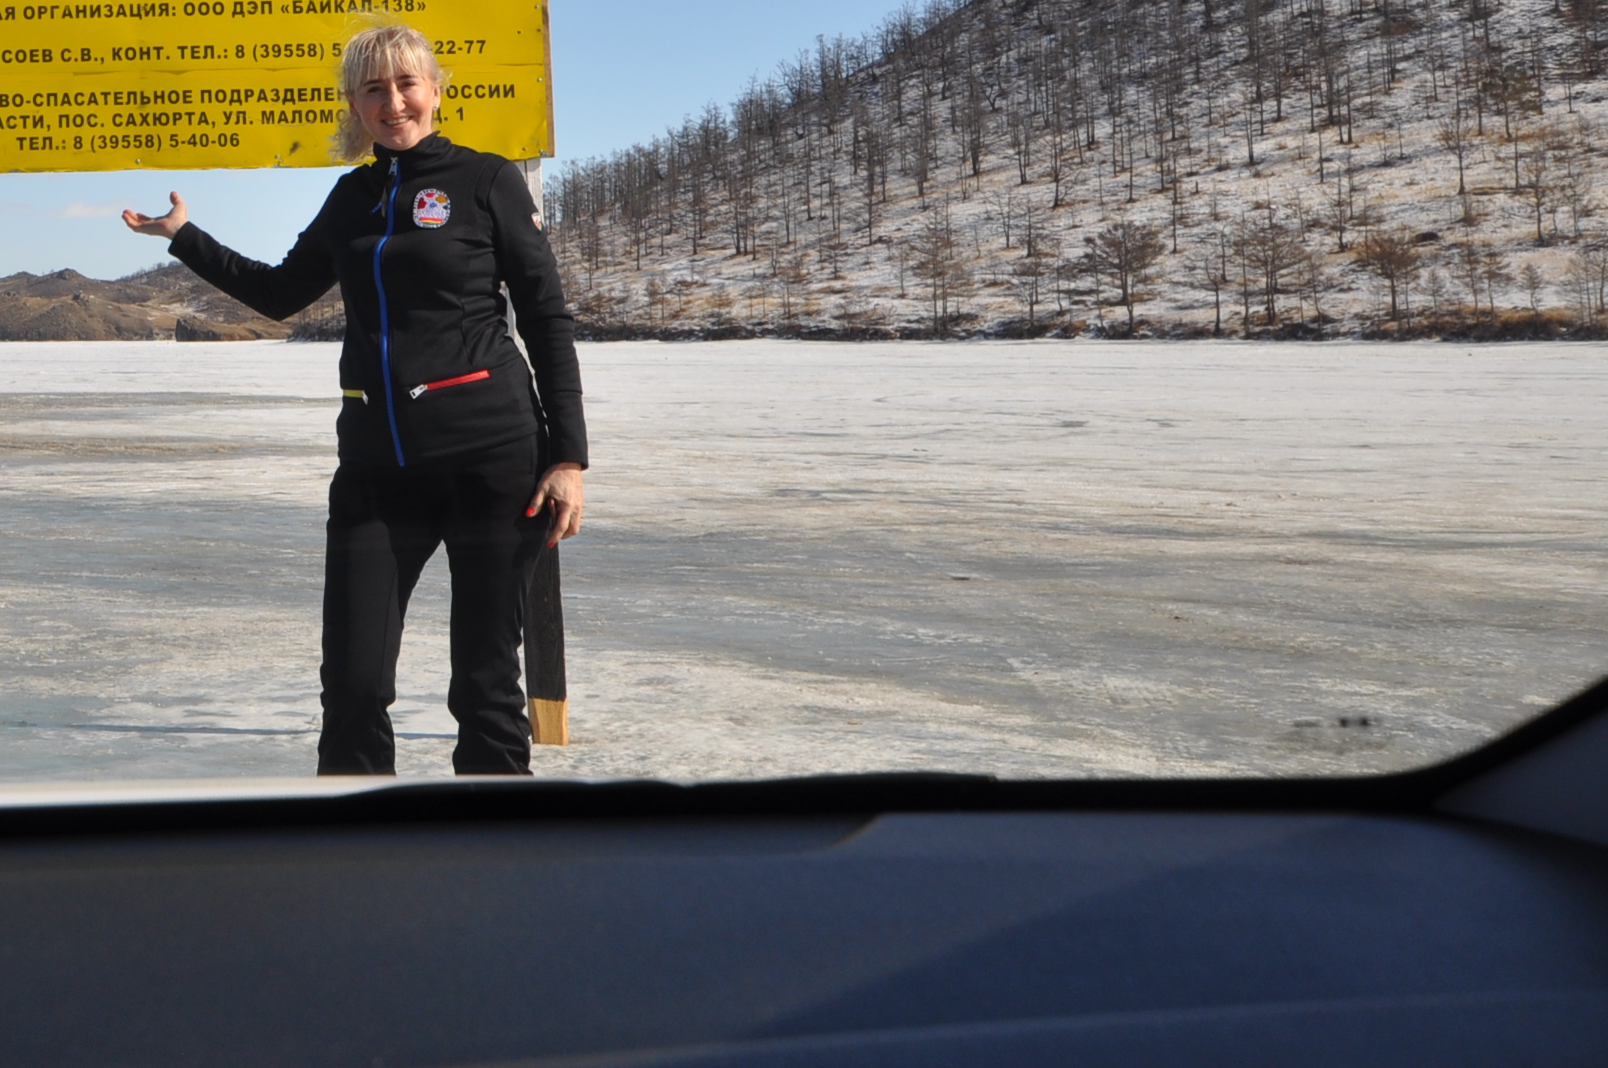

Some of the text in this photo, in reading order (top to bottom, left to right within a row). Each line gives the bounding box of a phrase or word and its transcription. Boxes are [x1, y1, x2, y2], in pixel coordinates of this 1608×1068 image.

[23, 2, 176, 20] ОРГАНИЗАЦИЯ:
[183, 1, 225, 17] ООО
[231, 0, 273, 18] ДЭП
[60, 47, 105, 64] С.В.,
[111, 46, 170, 61] КОНТ.
[176, 45, 228, 60] ТЕЛ.:
[235, 44, 245, 59] 8
[252, 43, 324, 62] (39558)
[199, 86, 344, 107] ПОДРАЗДЕЛЕ
[445, 83, 516, 100] ОССИИ
[58, 113, 105, 129] ПОС.
[111, 111, 216, 128] САХЮРТА,
[222, 110, 254, 126] УЛ.
[456, 106, 464, 121] 1
[15, 132, 240, 153] ТЕЛ.: 8 (39558) 5-40-06
